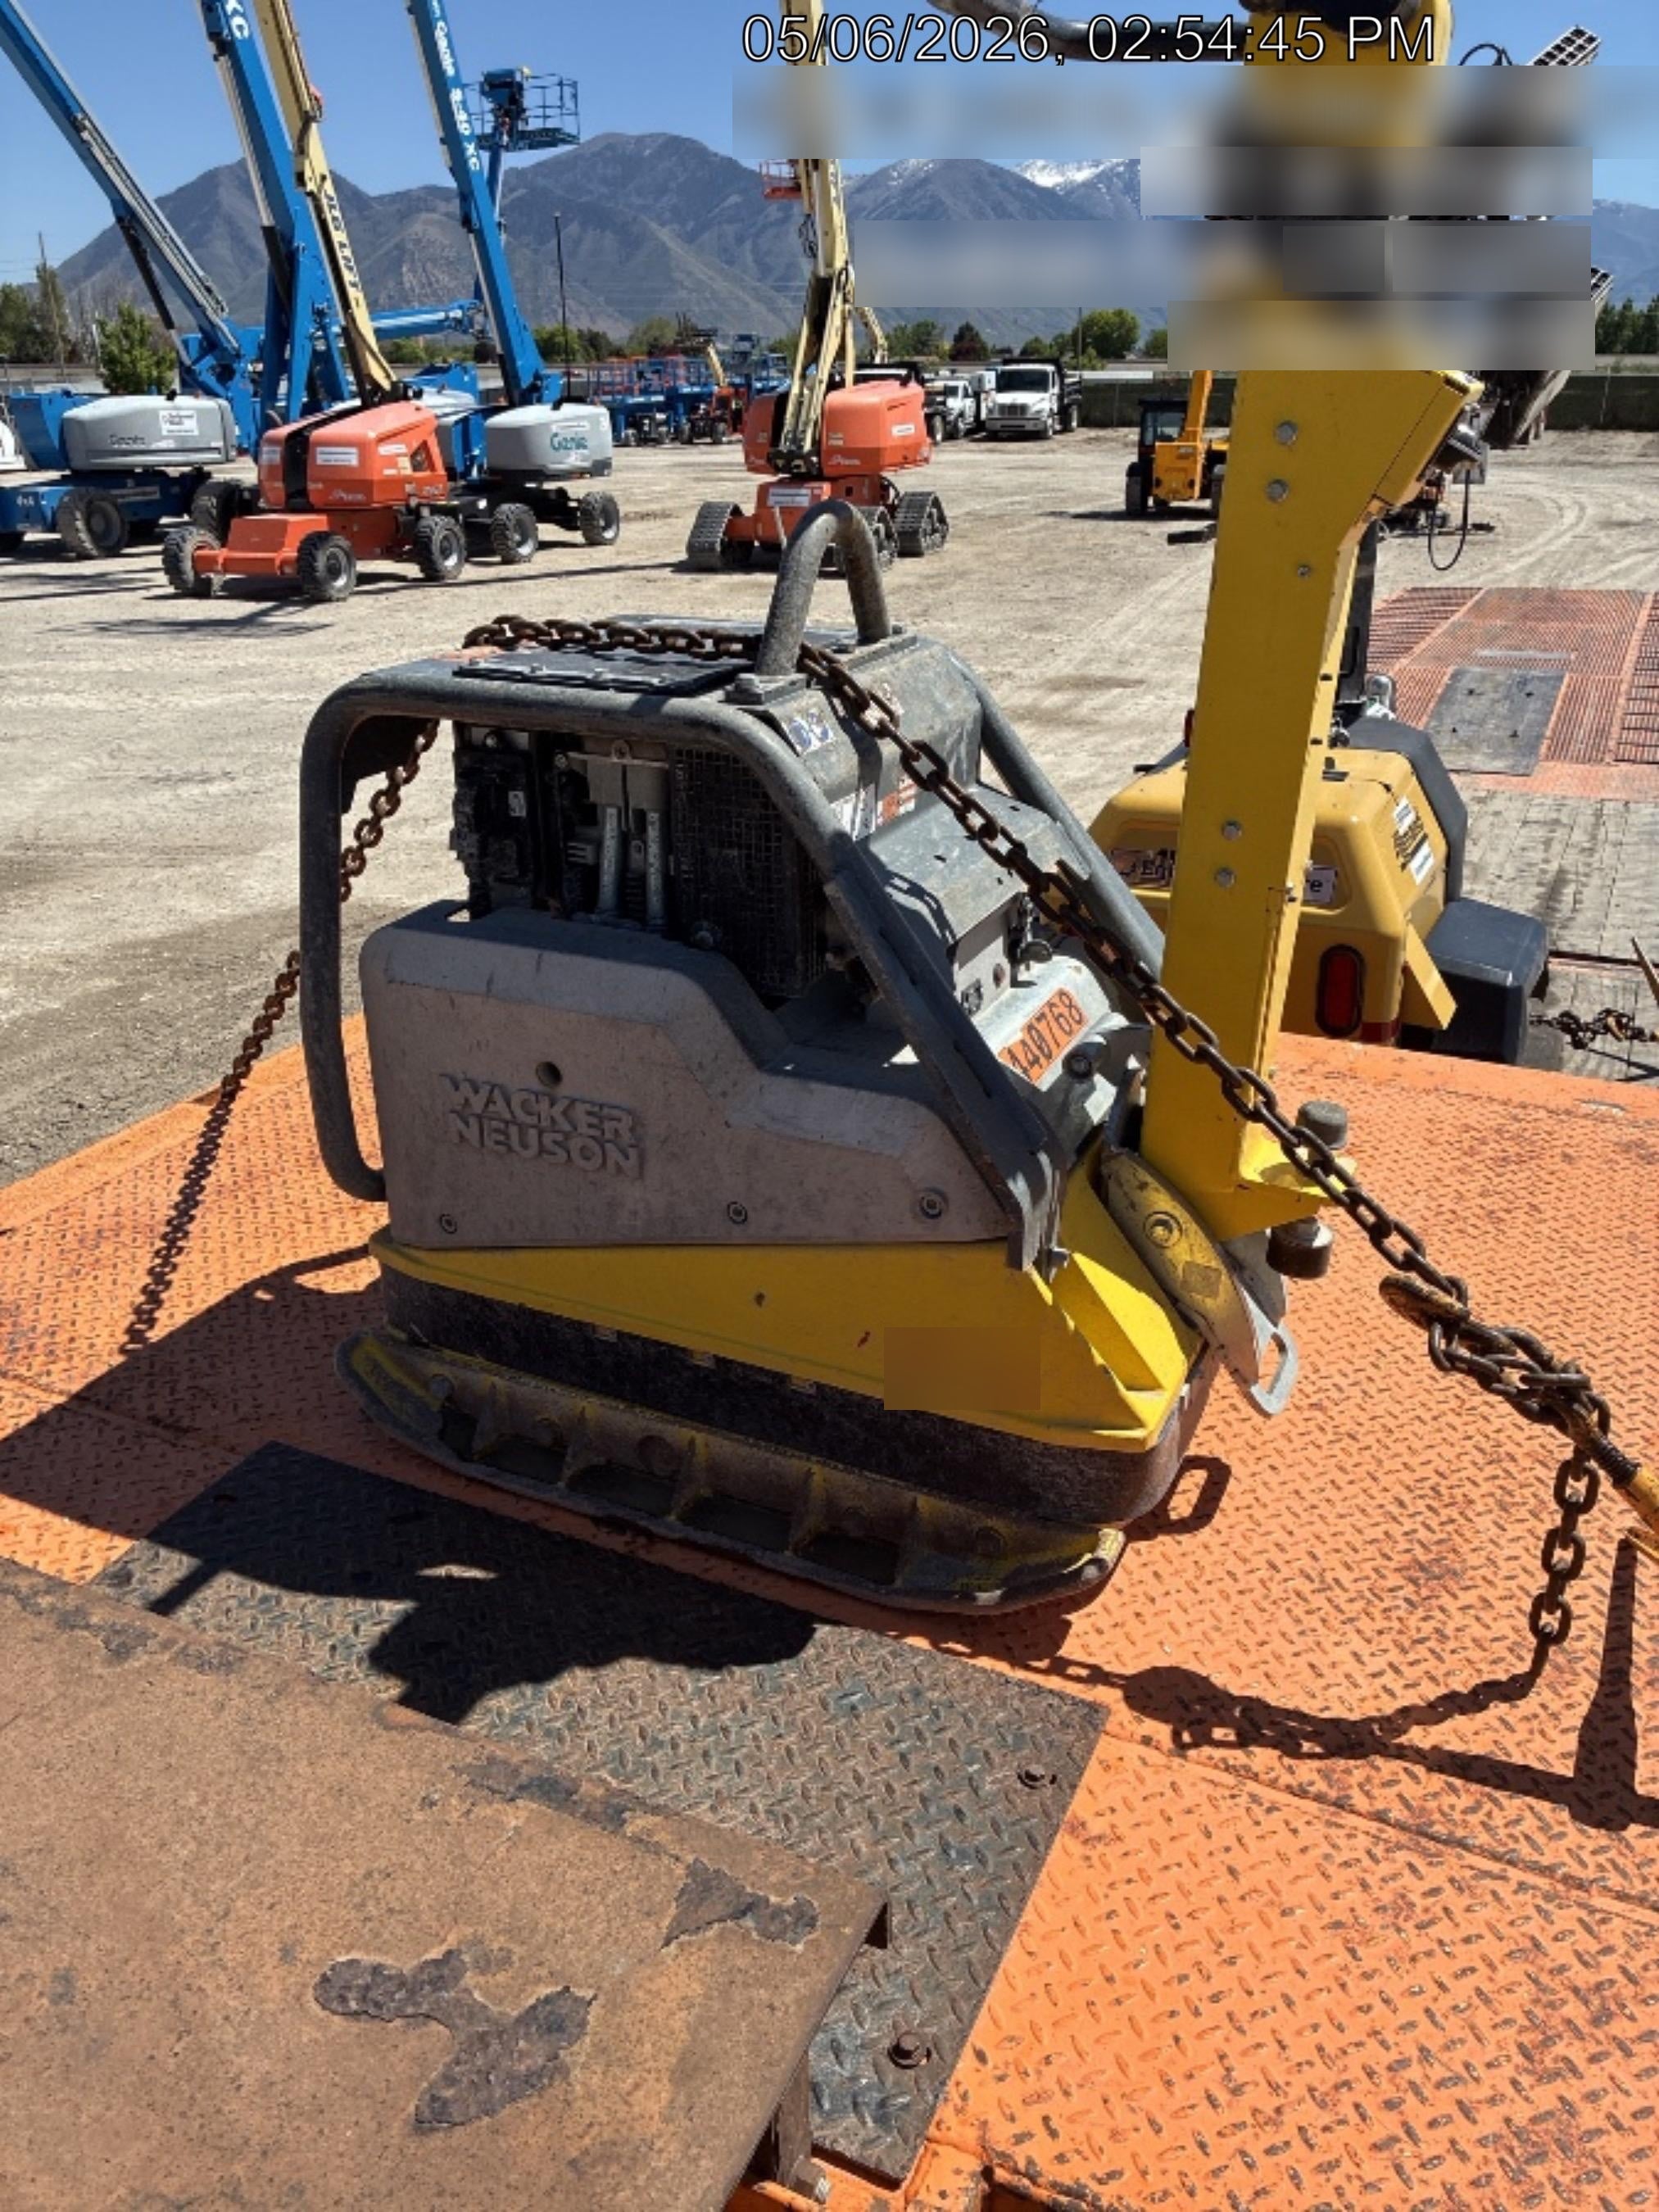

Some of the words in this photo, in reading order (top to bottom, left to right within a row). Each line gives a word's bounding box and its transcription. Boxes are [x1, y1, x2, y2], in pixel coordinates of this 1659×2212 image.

[550, 432, 588, 451] Genie
[439, 1072, 640, 1147] WACKER
[449, 1109, 646, 1180] NEUSON
